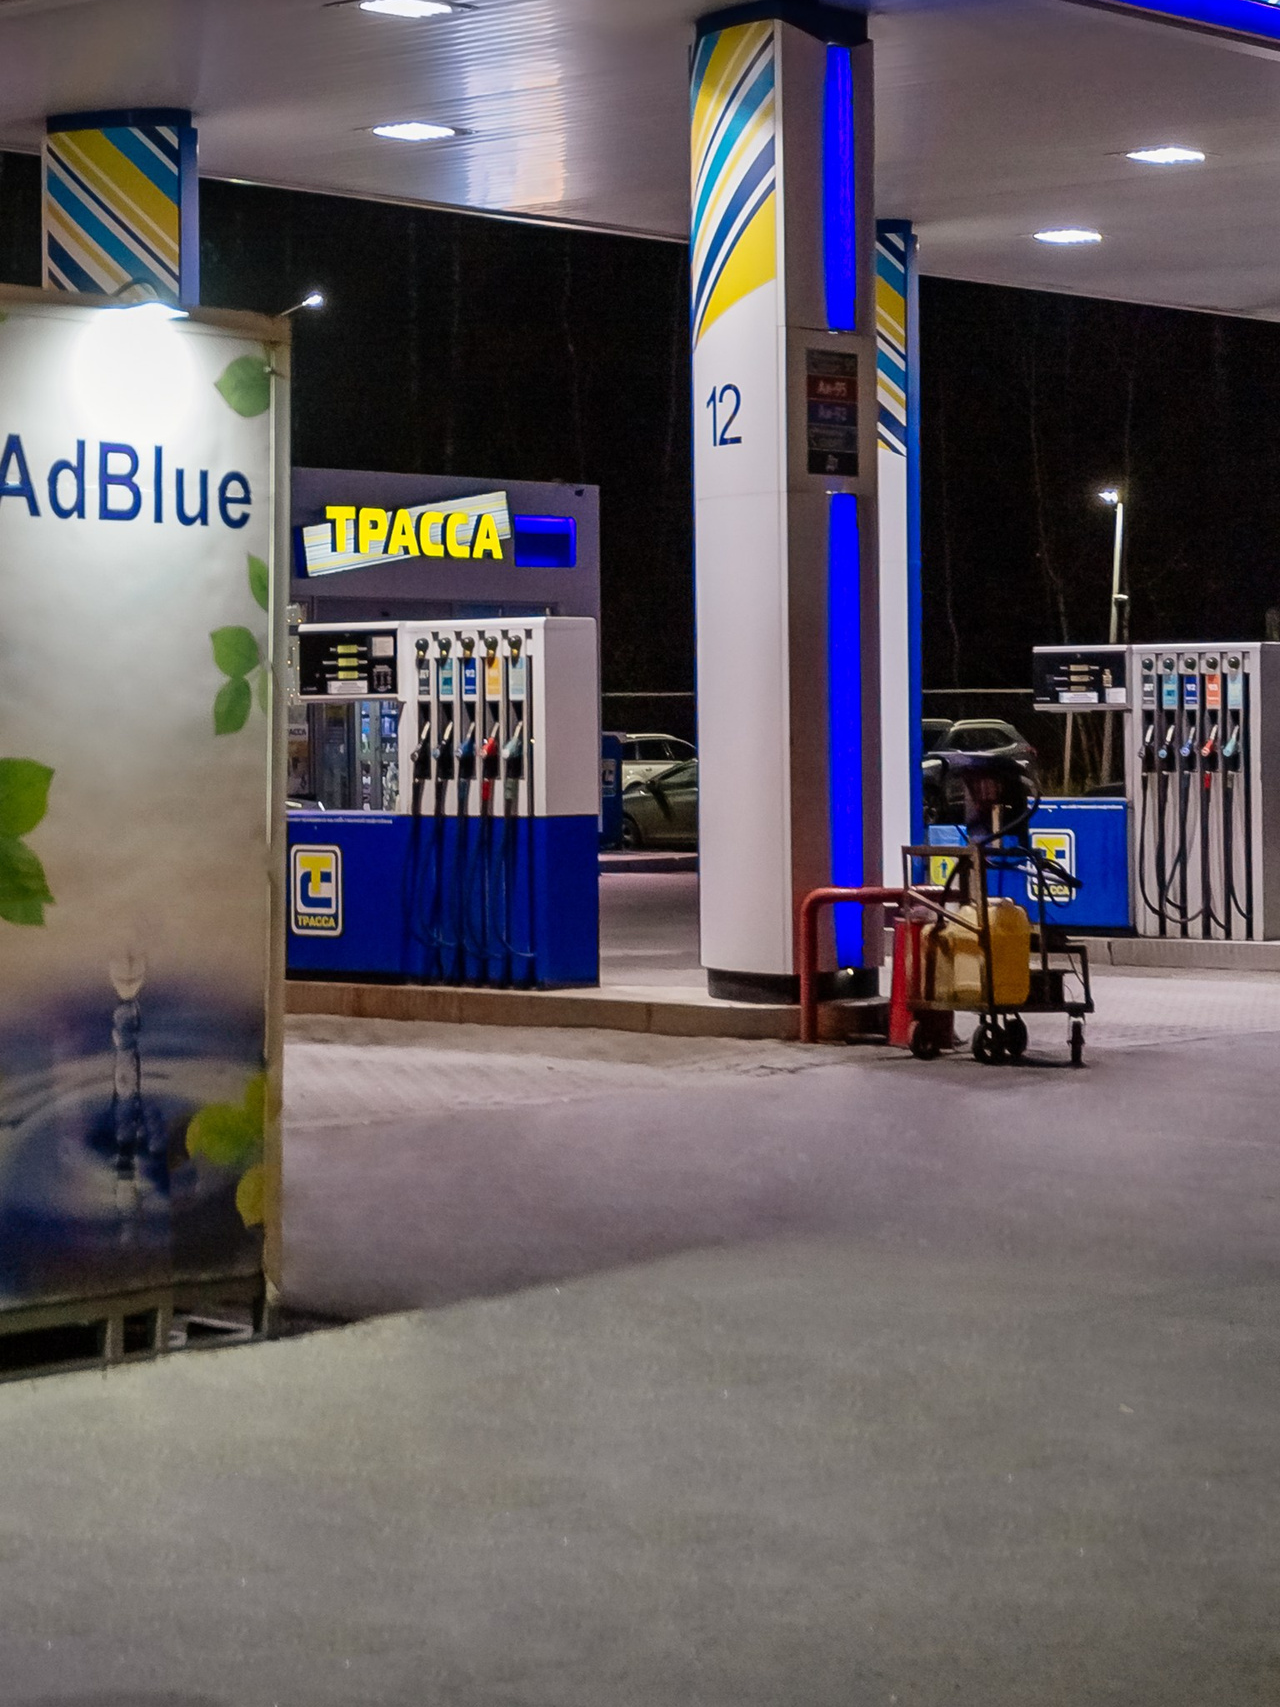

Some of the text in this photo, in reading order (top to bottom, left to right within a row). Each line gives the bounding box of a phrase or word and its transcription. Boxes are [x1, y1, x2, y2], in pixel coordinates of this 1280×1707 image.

[706, 383, 743, 447] 12
[326, 505, 503, 560] ТРАССА
[297, 915, 336, 929] ТРАССА
